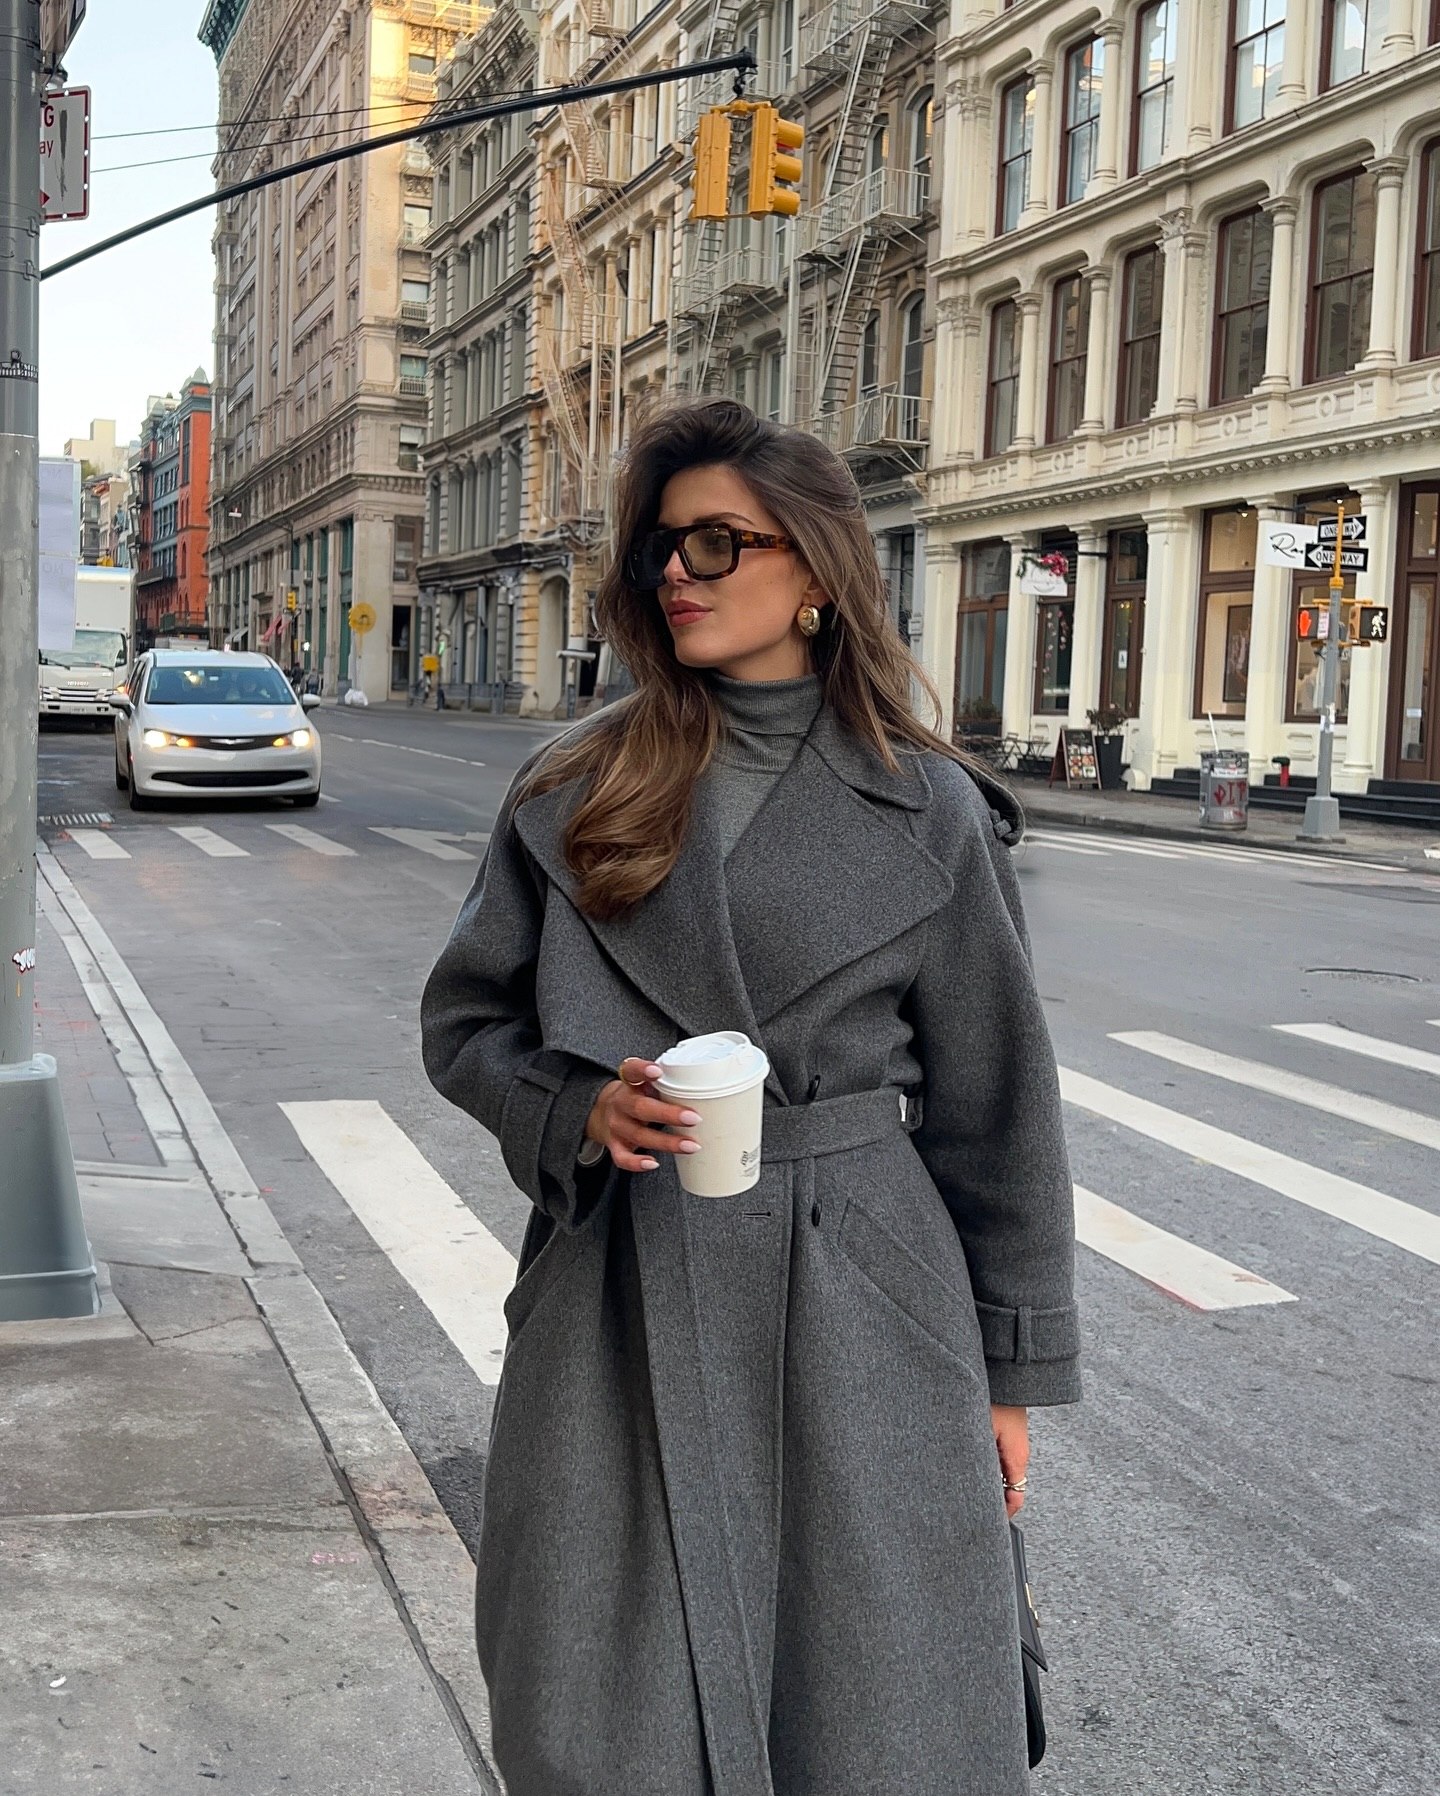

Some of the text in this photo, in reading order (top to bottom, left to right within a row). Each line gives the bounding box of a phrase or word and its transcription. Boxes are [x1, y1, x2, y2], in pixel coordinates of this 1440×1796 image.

[1324, 523, 1359, 537] ONE WAY
[1315, 551, 1360, 565] ONE WAY
